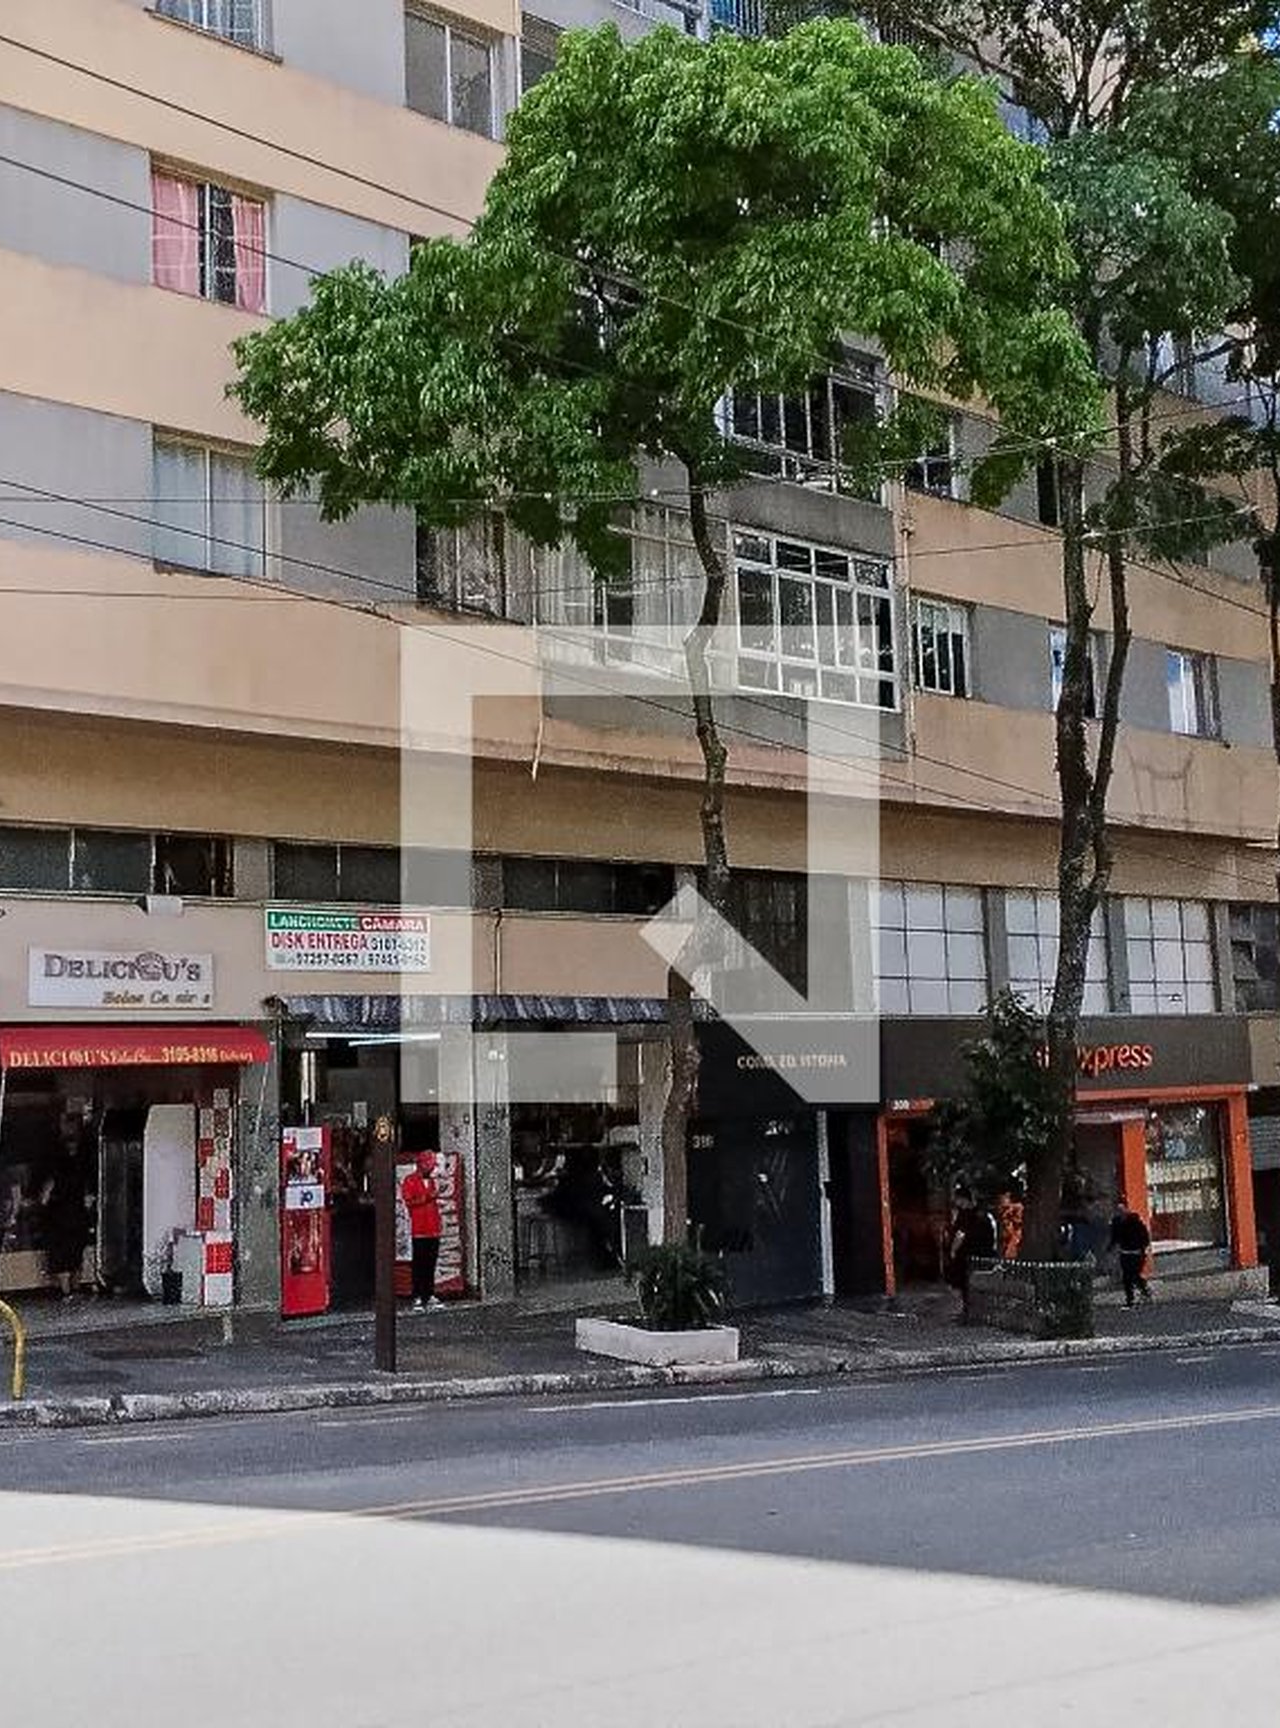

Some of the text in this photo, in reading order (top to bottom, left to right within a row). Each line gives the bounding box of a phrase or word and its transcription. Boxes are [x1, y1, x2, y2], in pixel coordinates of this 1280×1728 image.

[271, 932, 305, 950] DISK
[308, 933, 368, 951] ENTREGA
[1075, 1044, 1153, 1076] xpress
